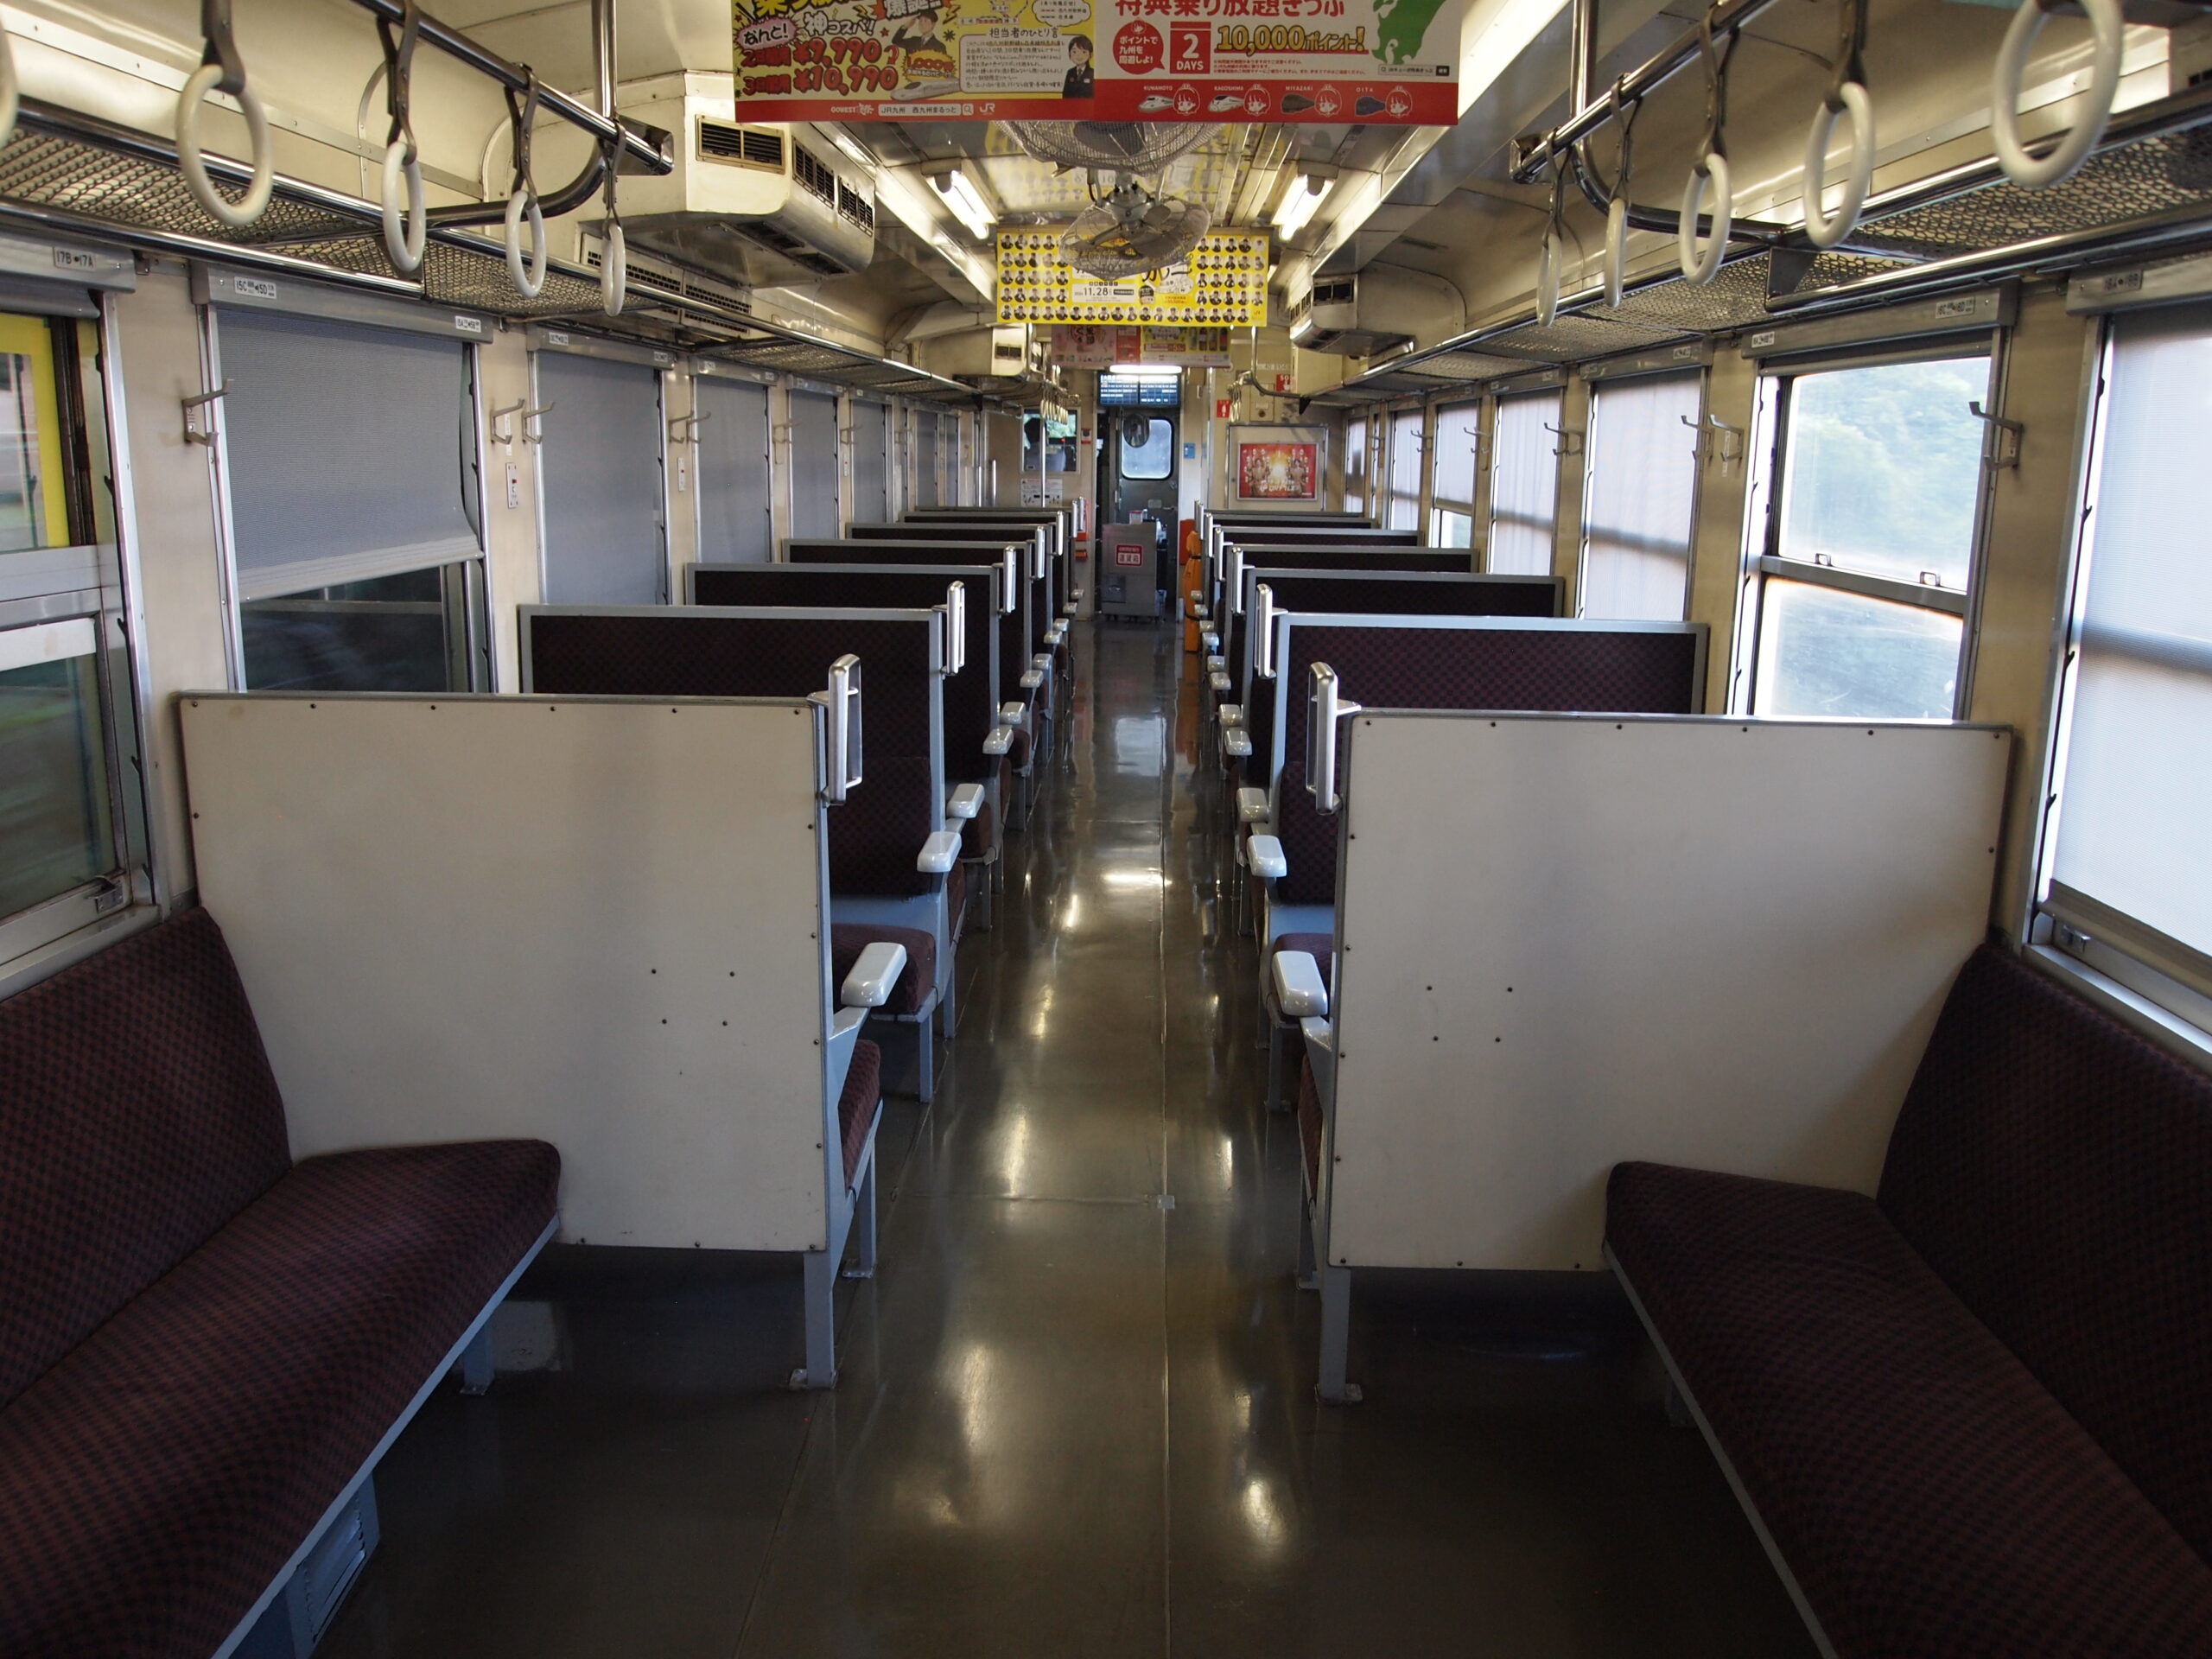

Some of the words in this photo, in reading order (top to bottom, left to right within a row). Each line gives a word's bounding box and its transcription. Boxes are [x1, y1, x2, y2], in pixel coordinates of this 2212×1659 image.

[989, 28, 1059, 38] 担当者のひとり言
[1182, 33, 1200, 59] 2
[1176, 60, 1204, 70] DAYS
[881, 105, 906, 114] JR九州
[56, 250, 72, 264] 17B
[1084, 287, 1109, 296] 11.28
